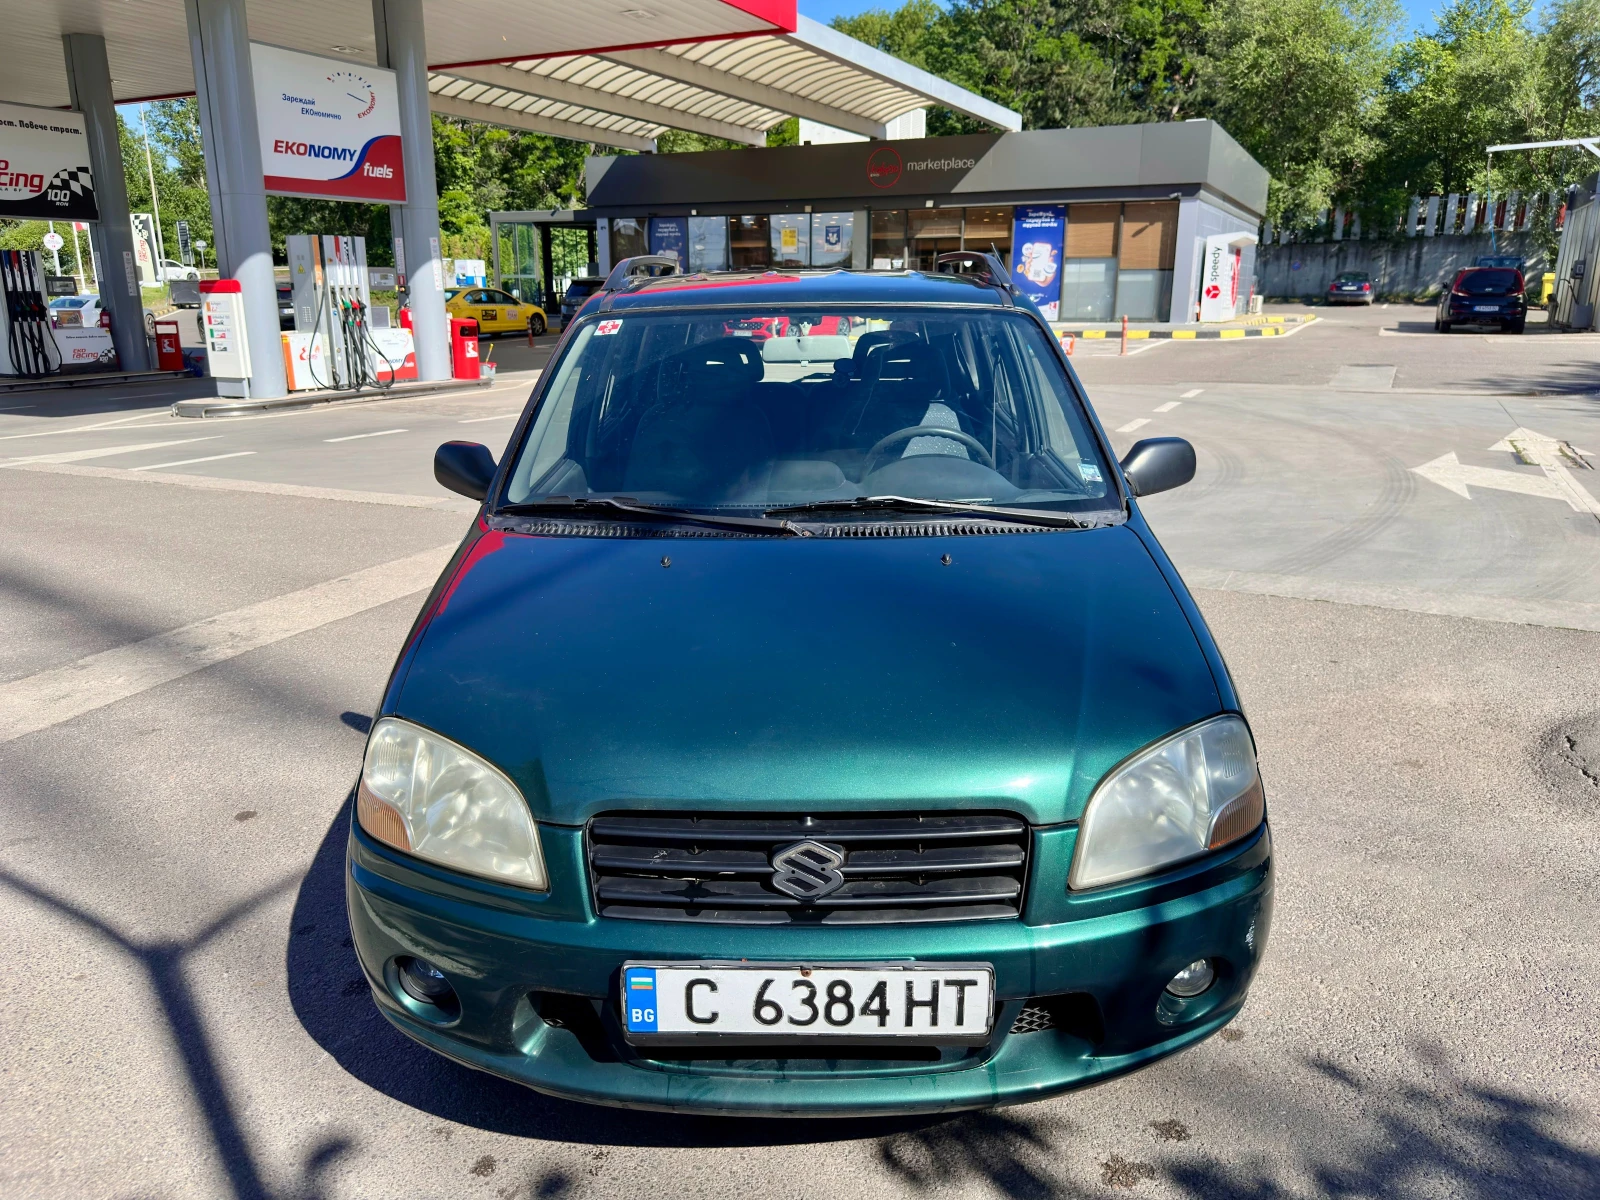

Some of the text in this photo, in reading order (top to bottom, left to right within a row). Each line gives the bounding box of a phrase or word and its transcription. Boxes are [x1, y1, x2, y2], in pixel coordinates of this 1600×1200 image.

[281, 93, 315, 106] Зареждай
[301, 107, 342, 120] ЕКОномично
[273, 139, 357, 162] EKONOMY
[363, 162, 393, 179] fuels
[907, 157, 975, 172] marketplace
[47, 188, 71, 202] 100
[1210, 246, 1223, 282] speedy
[72, 352, 99, 360] racing
[684, 977, 978, 1028] C 6384HT
[631, 1009, 655, 1022] BG
